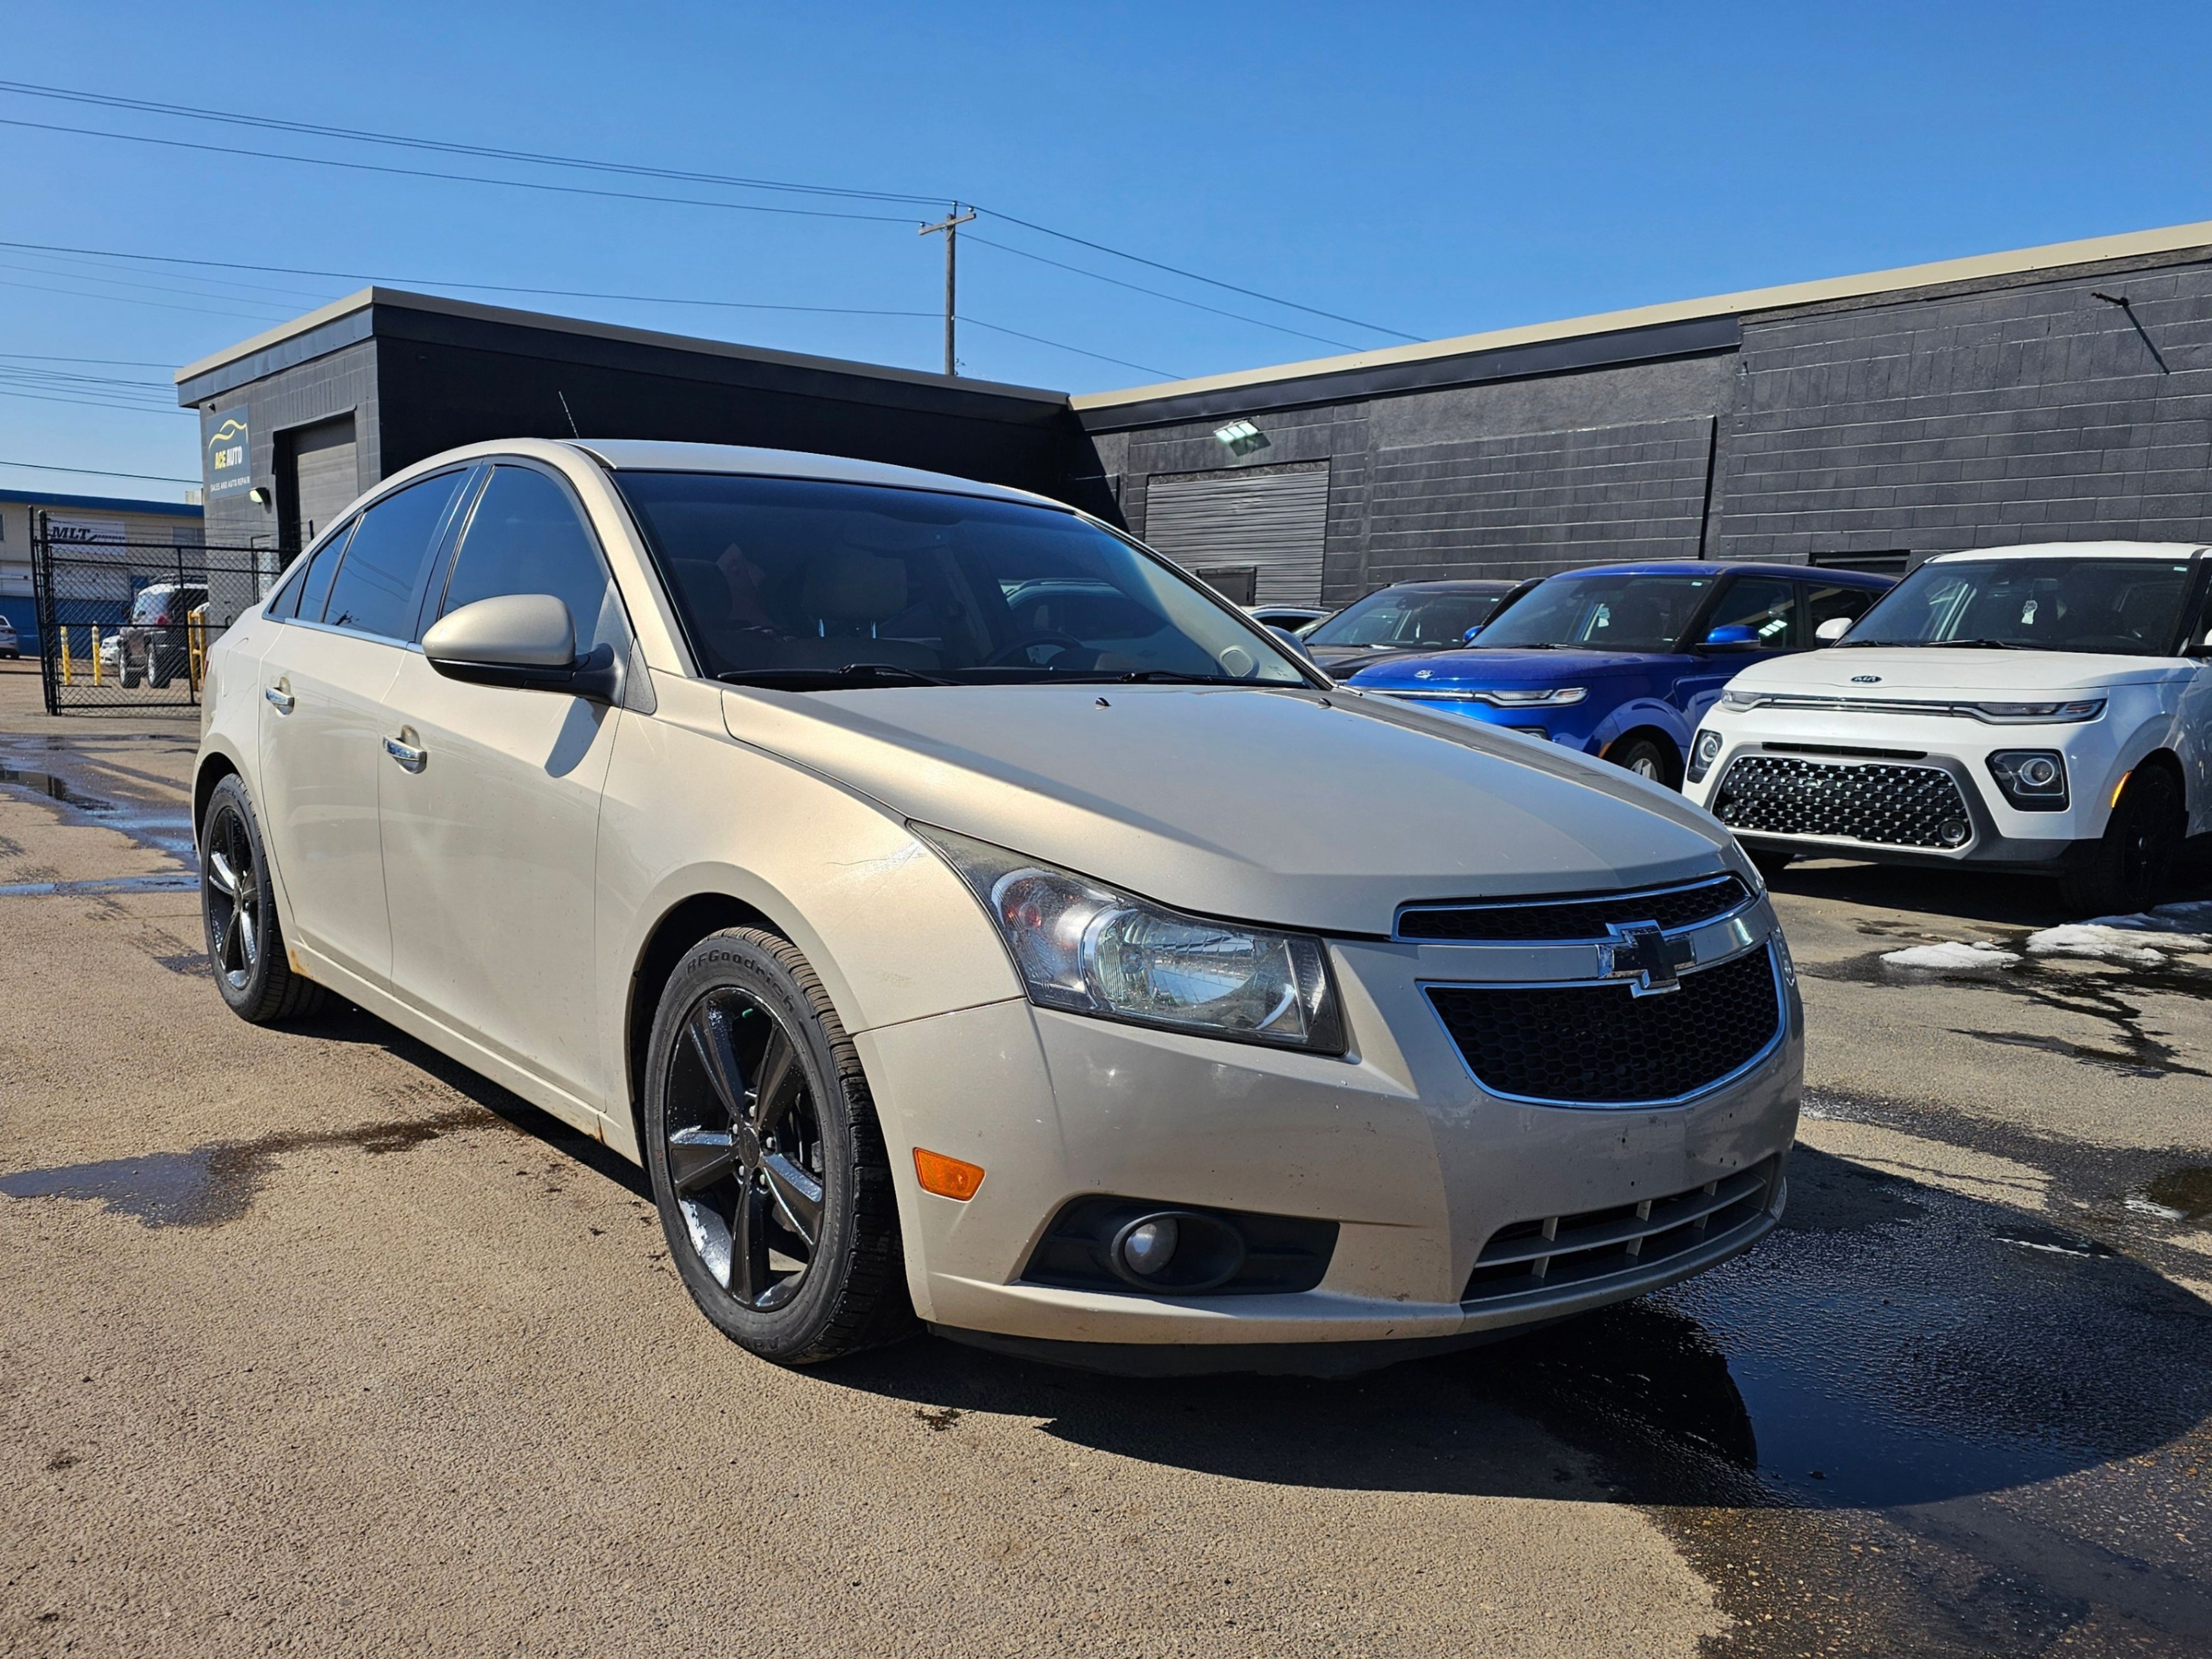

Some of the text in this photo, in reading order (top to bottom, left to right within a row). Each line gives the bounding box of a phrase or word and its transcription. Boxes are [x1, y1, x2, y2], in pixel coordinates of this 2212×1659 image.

[226, 445, 243, 467] AUTO
[50, 527, 90, 540] MLT
[686, 949, 795, 1014] BFGoodrich
